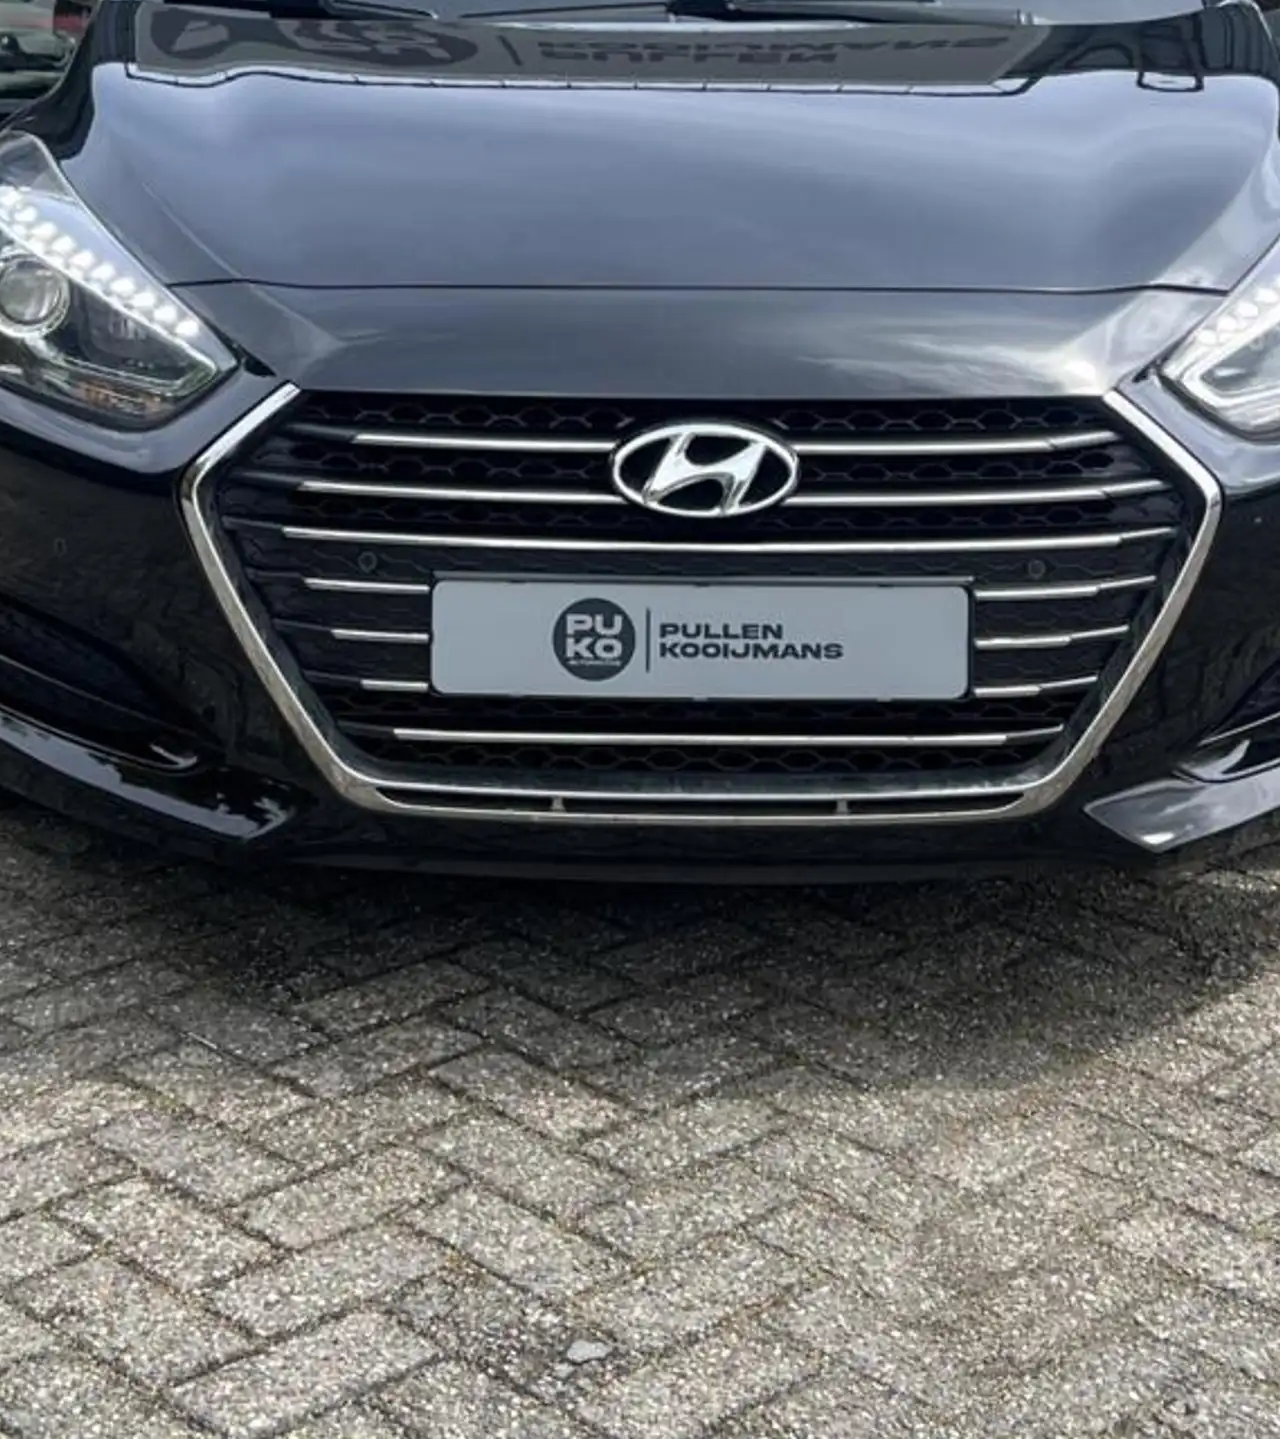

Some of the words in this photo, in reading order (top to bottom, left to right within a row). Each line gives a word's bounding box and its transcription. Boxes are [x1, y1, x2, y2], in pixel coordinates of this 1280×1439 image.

[566, 613, 623, 636] PU
[659, 622, 783, 641] PULLEN
[566, 637, 623, 659] KO
[659, 642, 844, 660] KOOIJMANS
